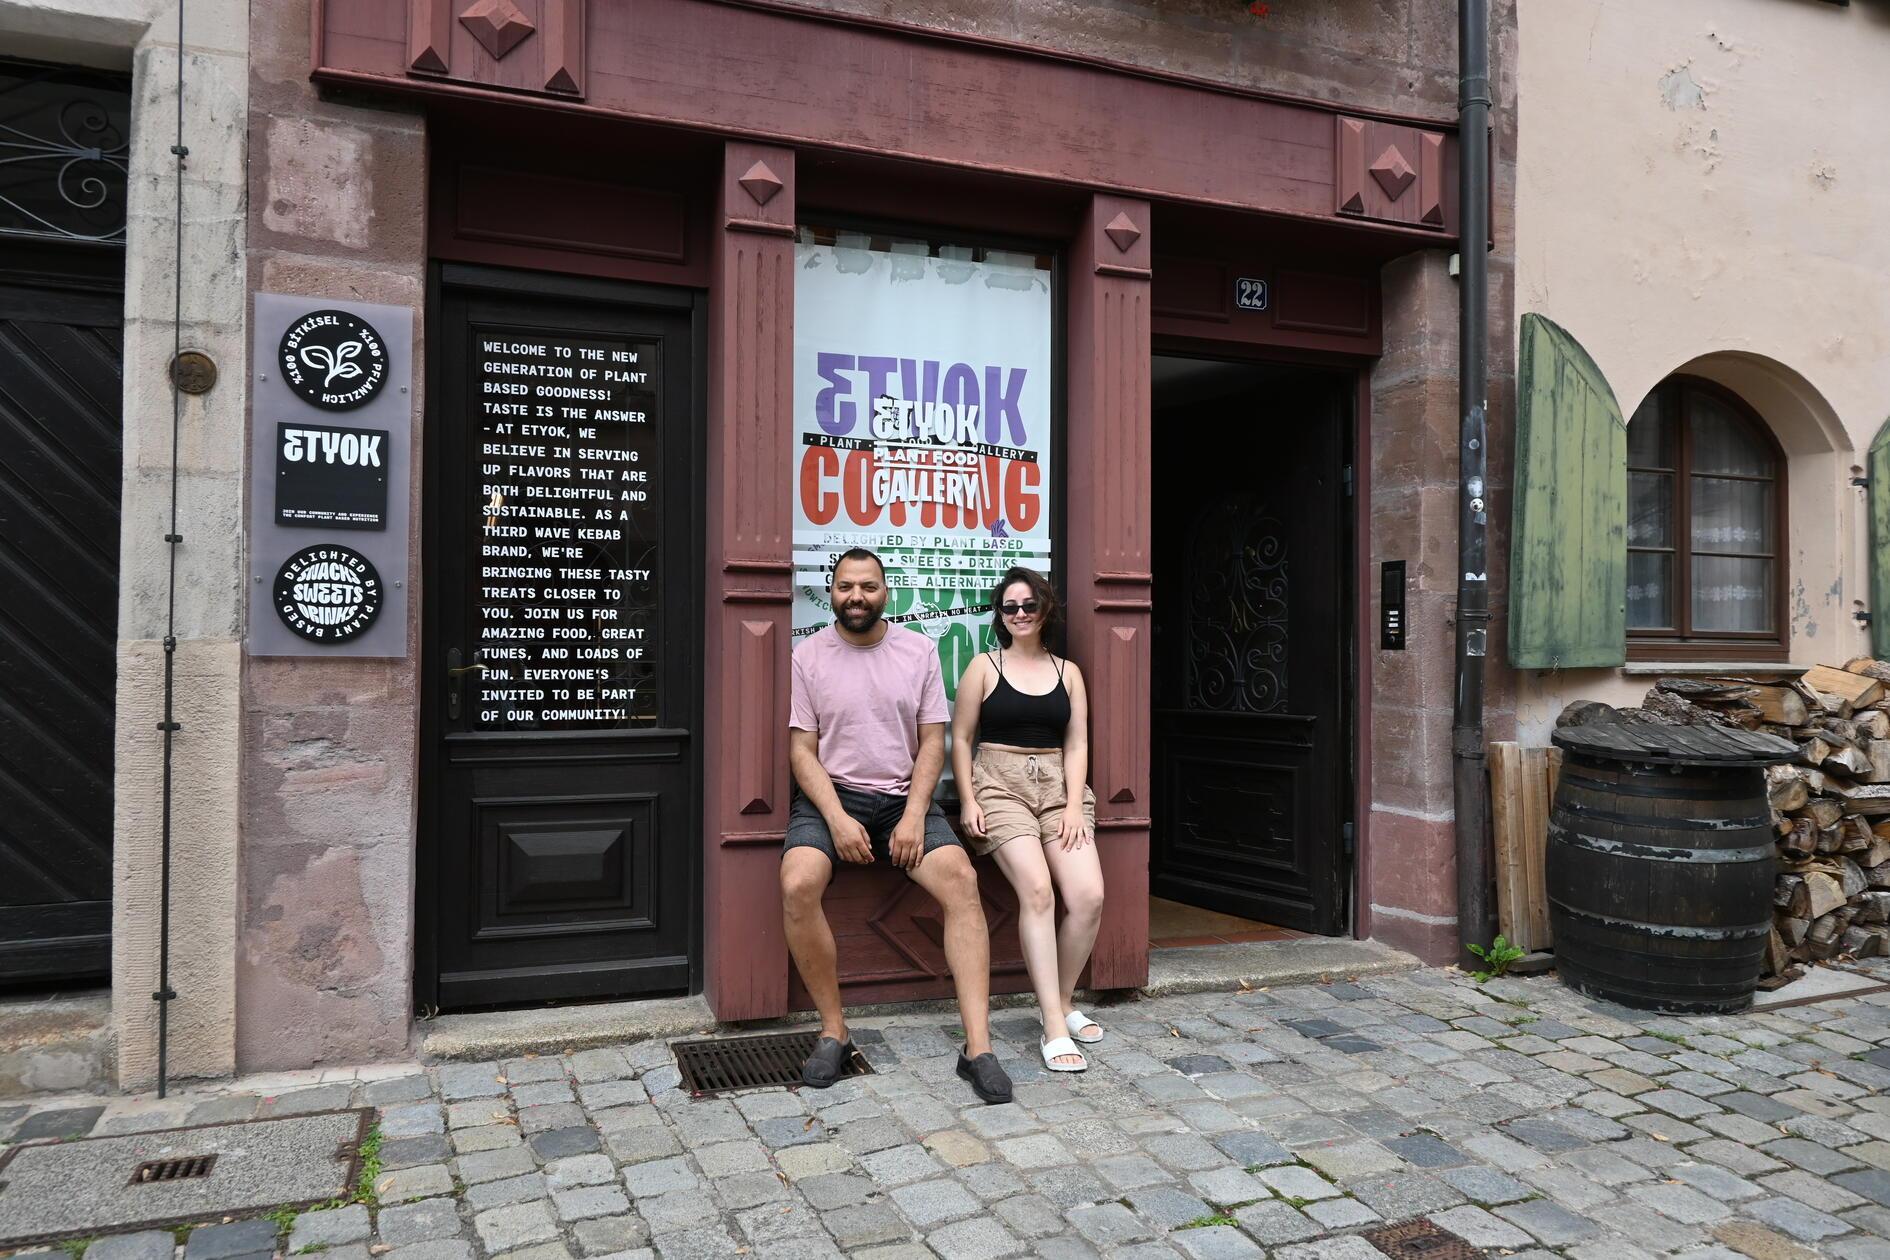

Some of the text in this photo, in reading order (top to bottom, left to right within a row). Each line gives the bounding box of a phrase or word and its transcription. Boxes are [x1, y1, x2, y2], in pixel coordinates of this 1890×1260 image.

[1241, 281, 1262, 306] 22
[484, 342, 637, 363] WELCOME TO THE NEW
[484, 362, 647, 383] GENERATION OF PLANT
[322, 364, 382, 404] PFLANZLICH
[484, 383, 610, 400] BASED GOODNESS!
[816, 352, 1028, 446] ETYOK
[484, 403, 645, 422] TASTE IS THE ANSWER
[873, 398, 978, 444] ETYOK
[496, 424, 513, 434] AT
[522, 425, 570, 439] ETYOK,
[579, 428, 596, 439] WE
[284, 429, 381, 467] ETYOK
[820, 436, 861, 450] PLANT
[484, 444, 638, 461] BELIEVE IN SERVING
[874, 447, 978, 466] PLANT FOOD
[483, 465, 647, 482] UP FLAVORS THAT ARE
[483, 485, 646, 501] BOTH DELIGHTFUL AND
[873, 468, 978, 511] GALLERY
[483, 506, 628, 520] SUSTAINABLE. AS A
[483, 526, 621, 540] THIRD WAVE KEBAB
[823, 532, 1023, 551] DELIGHTED BY PLANT BASED
[483, 546, 583, 558] BRAND, WE'RE
[900, 555, 1018, 568] SWEETS DRINKS
[296, 562, 361, 585] SNACKS
[483, 567, 649, 580] BRINGING THESE TASTY
[283, 551, 376, 637] DELIGHTED BY PLANT BASED
[293, 583, 364, 604] SWEETS
[482, 588, 620, 600] TREATS CLOSER TO
[297, 602, 358, 625] DRINKS
[482, 608, 617, 619] YOU. JOIN US FOR
[951, 608, 961, 616] NO
[482, 628, 644, 640] AMAZING FOOD, GREAT
[482, 649, 643, 660] TUNES, AND LOADS OF
[482, 670, 608, 680] FUN. EVERYONE'S
[482, 689, 635, 700] INVITED TO BE PART
[481, 709, 625, 721] OF OUR COMMUNITY!
